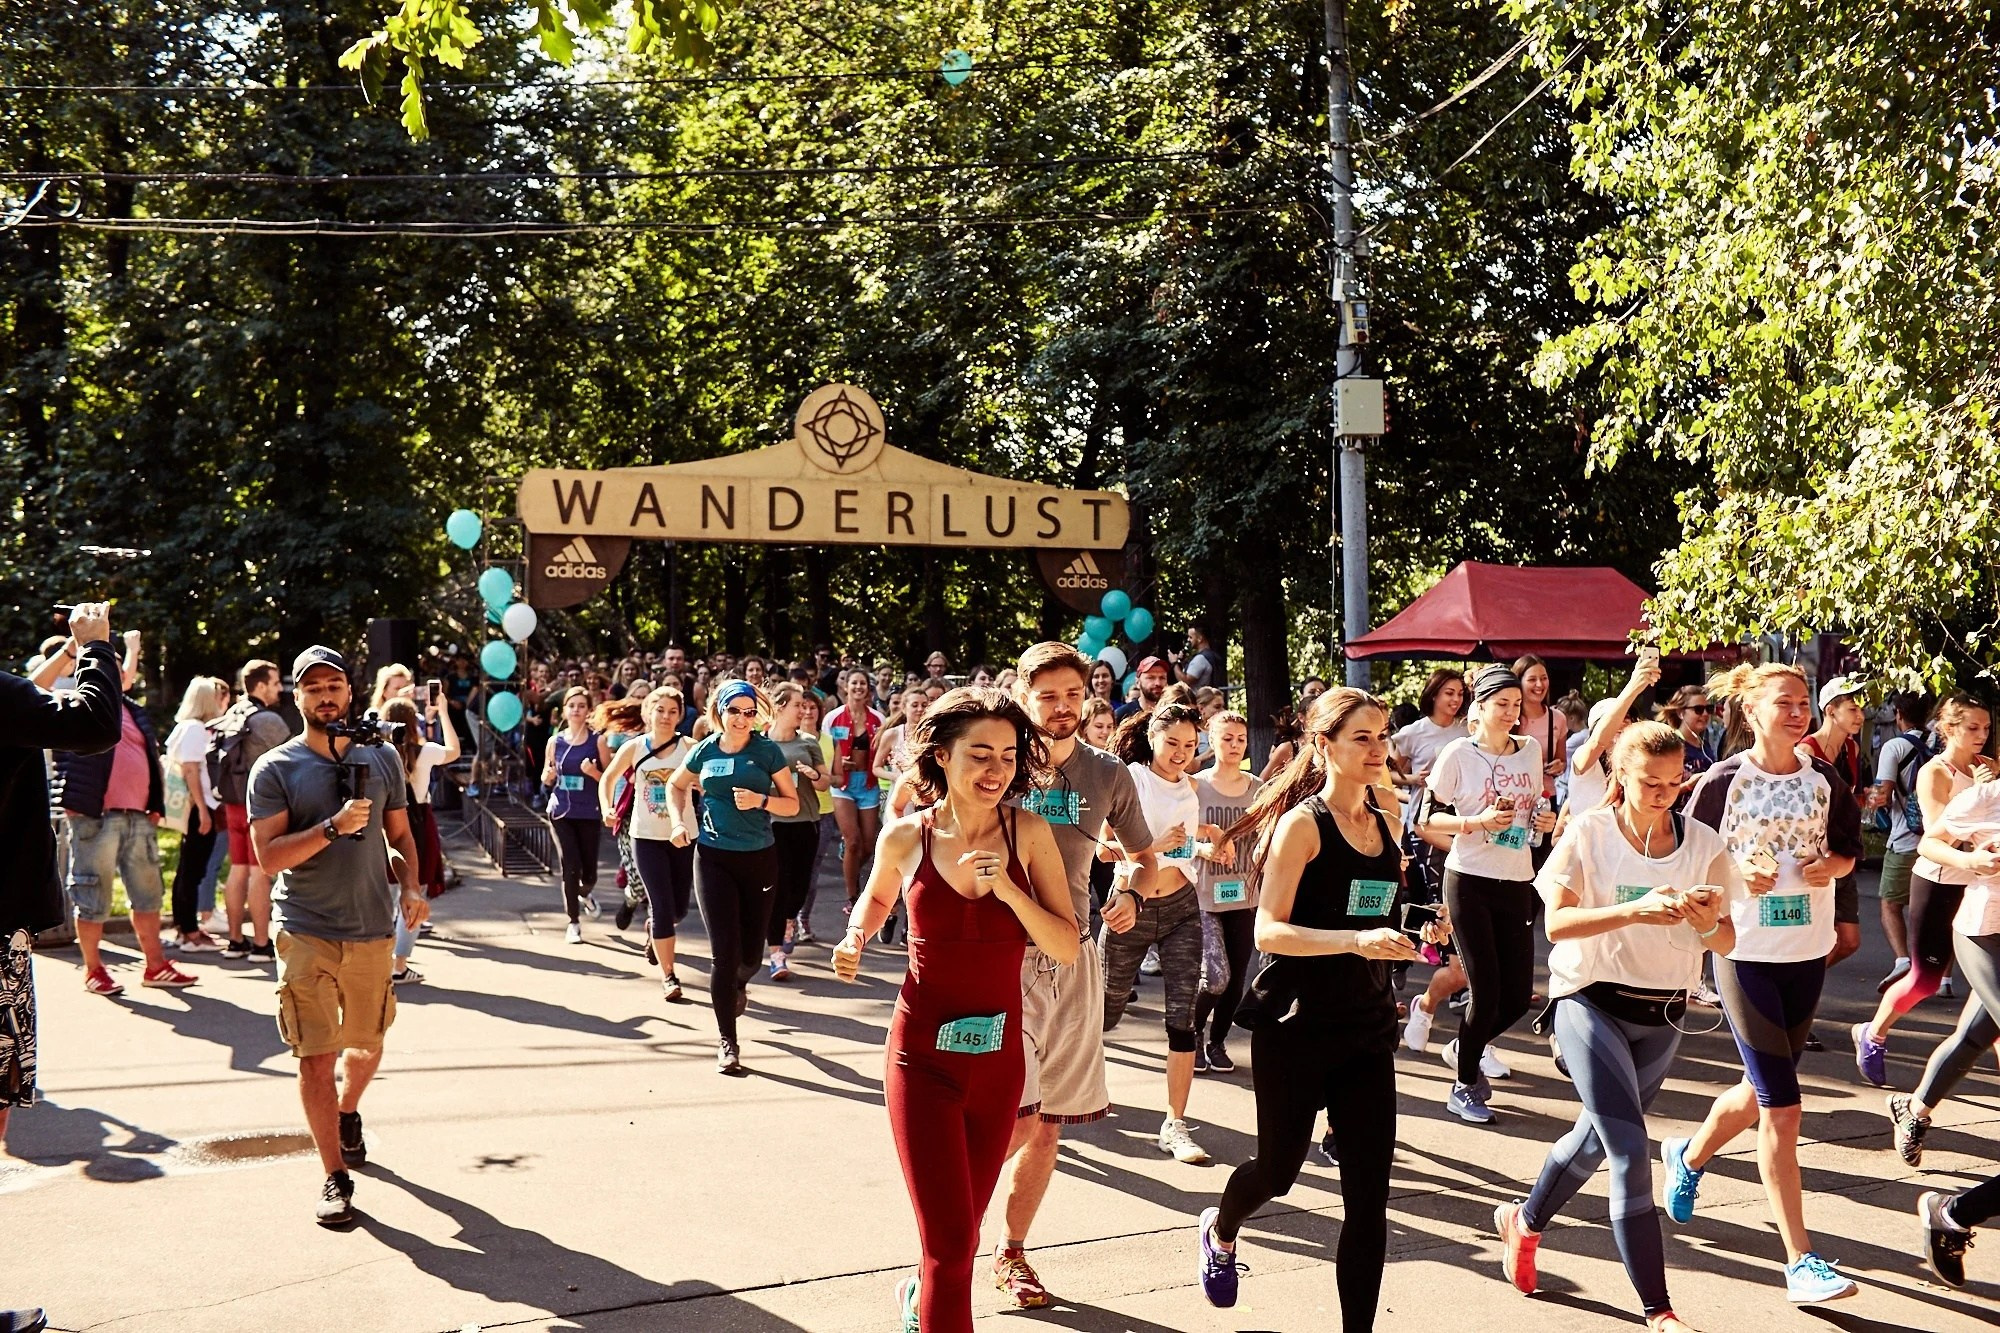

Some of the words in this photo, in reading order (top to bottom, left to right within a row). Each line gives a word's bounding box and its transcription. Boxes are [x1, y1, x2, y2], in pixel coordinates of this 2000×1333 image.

[552, 479, 1111, 540] WANDERLUST
[545, 562, 607, 579] adidas
[1057, 575, 1108, 589] adidas
[1494, 764, 1532, 788] Sun
[1036, 804, 1065, 817] 1452
[1498, 832, 1519, 845] 0882
[1221, 889, 1238, 899] 0630
[1359, 895, 1382, 909] 0853
[1773, 908, 1801, 921] 1140
[954, 1031, 988, 1046] 1451
